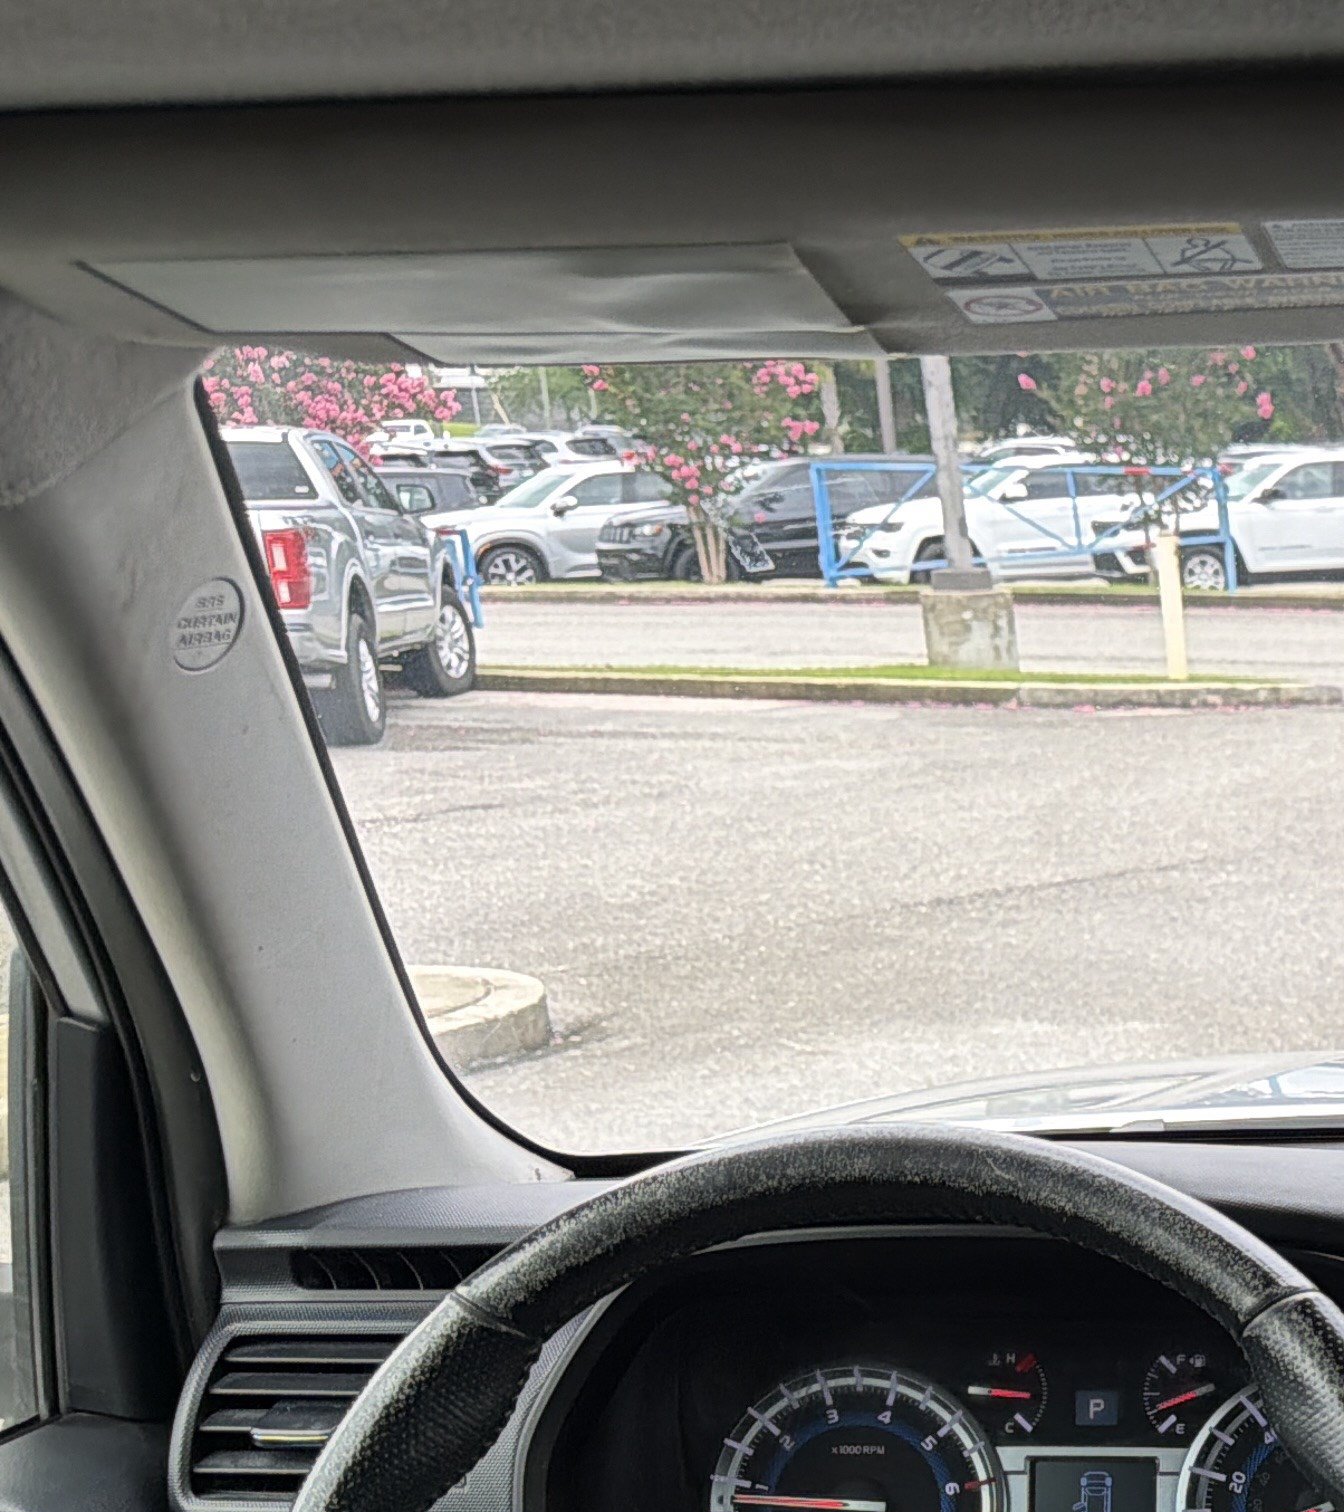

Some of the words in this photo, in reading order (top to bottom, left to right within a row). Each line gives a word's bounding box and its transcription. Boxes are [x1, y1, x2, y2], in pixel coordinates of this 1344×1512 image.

[1006, 1354, 1016, 1364] H
[1176, 1354, 1187, 1366] F
[1088, 1397, 1105, 1420] P
[825, 1408, 840, 1425] 3
[876, 1410, 892, 1425] 4
[1004, 1421, 1015, 1434] C
[1174, 1422, 1185, 1435] E
[778, 1434, 796, 1450] 2
[920, 1435, 938, 1452] 5
[755, 1482, 769, 1491] 1
[944, 1481, 961, 1496] 6
[1228, 1470, 1247, 1494] 20
